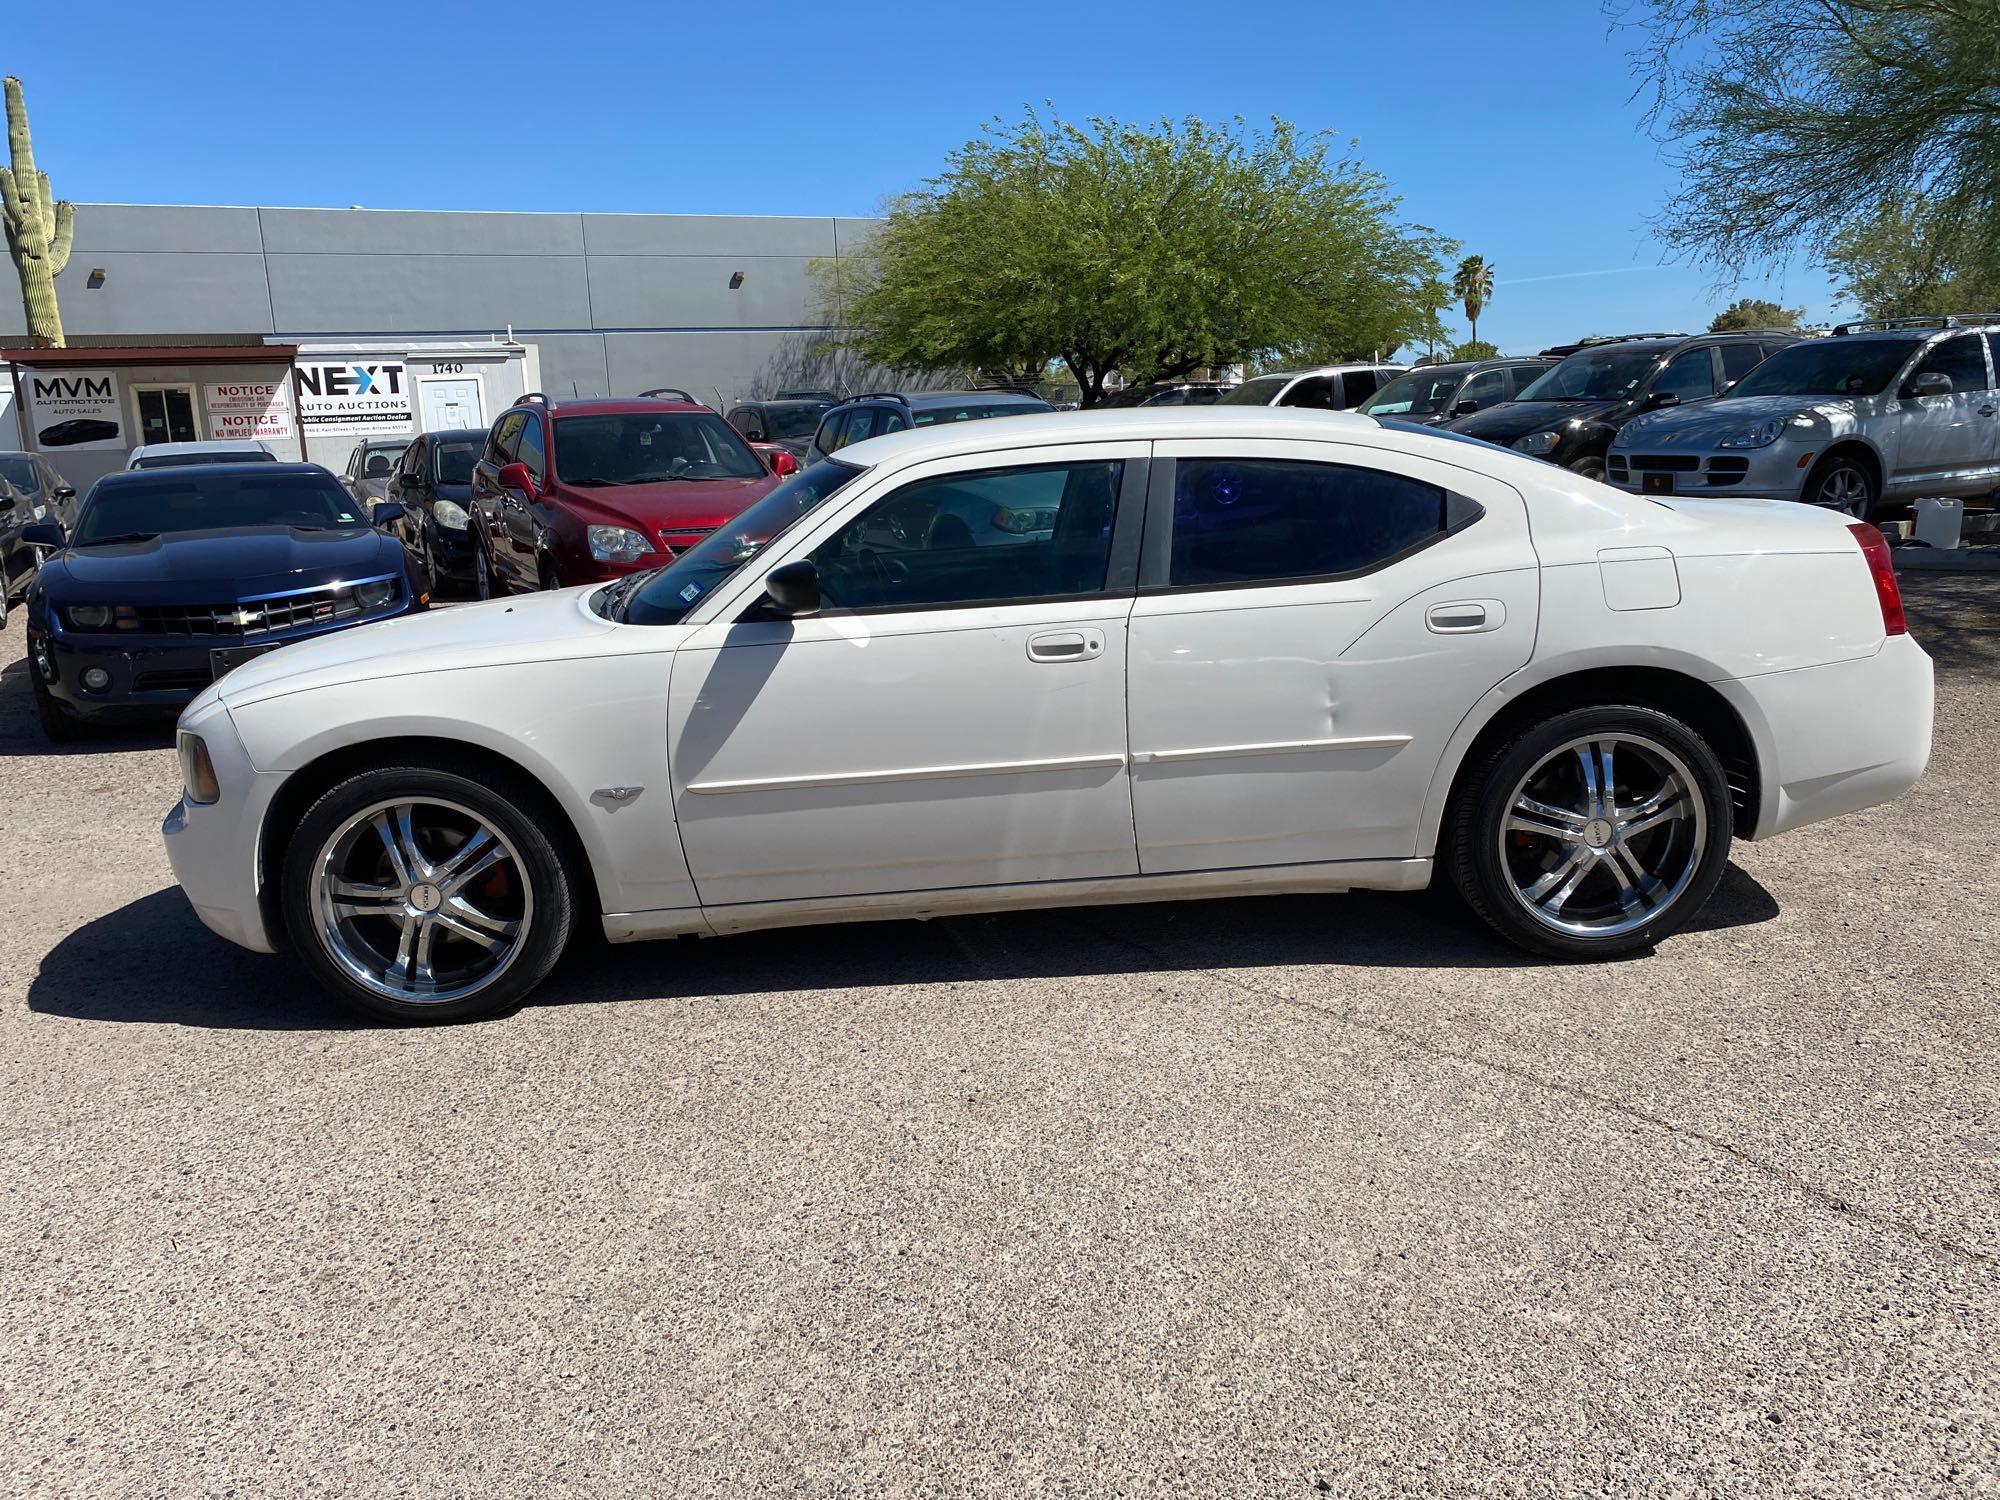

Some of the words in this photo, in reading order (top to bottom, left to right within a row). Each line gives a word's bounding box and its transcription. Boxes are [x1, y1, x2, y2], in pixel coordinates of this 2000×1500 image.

[432, 363, 463, 375] 1740
[296, 366, 402, 395] NEXT
[33, 377, 112, 398] MVM
[218, 386, 274, 395] NOTICE
[77, 407, 102, 415] SALES
[299, 403, 333, 411] AUTO
[338, 401, 407, 410] AUCTIONS
[222, 416, 278, 425] NOTICE
[320, 415, 361, 424] Consignment
[362, 414, 386, 422] Auction
[215, 429, 225, 437] NO
[227, 428, 252, 437] IMPLIED
[254, 427, 287, 436] WARRANTY
